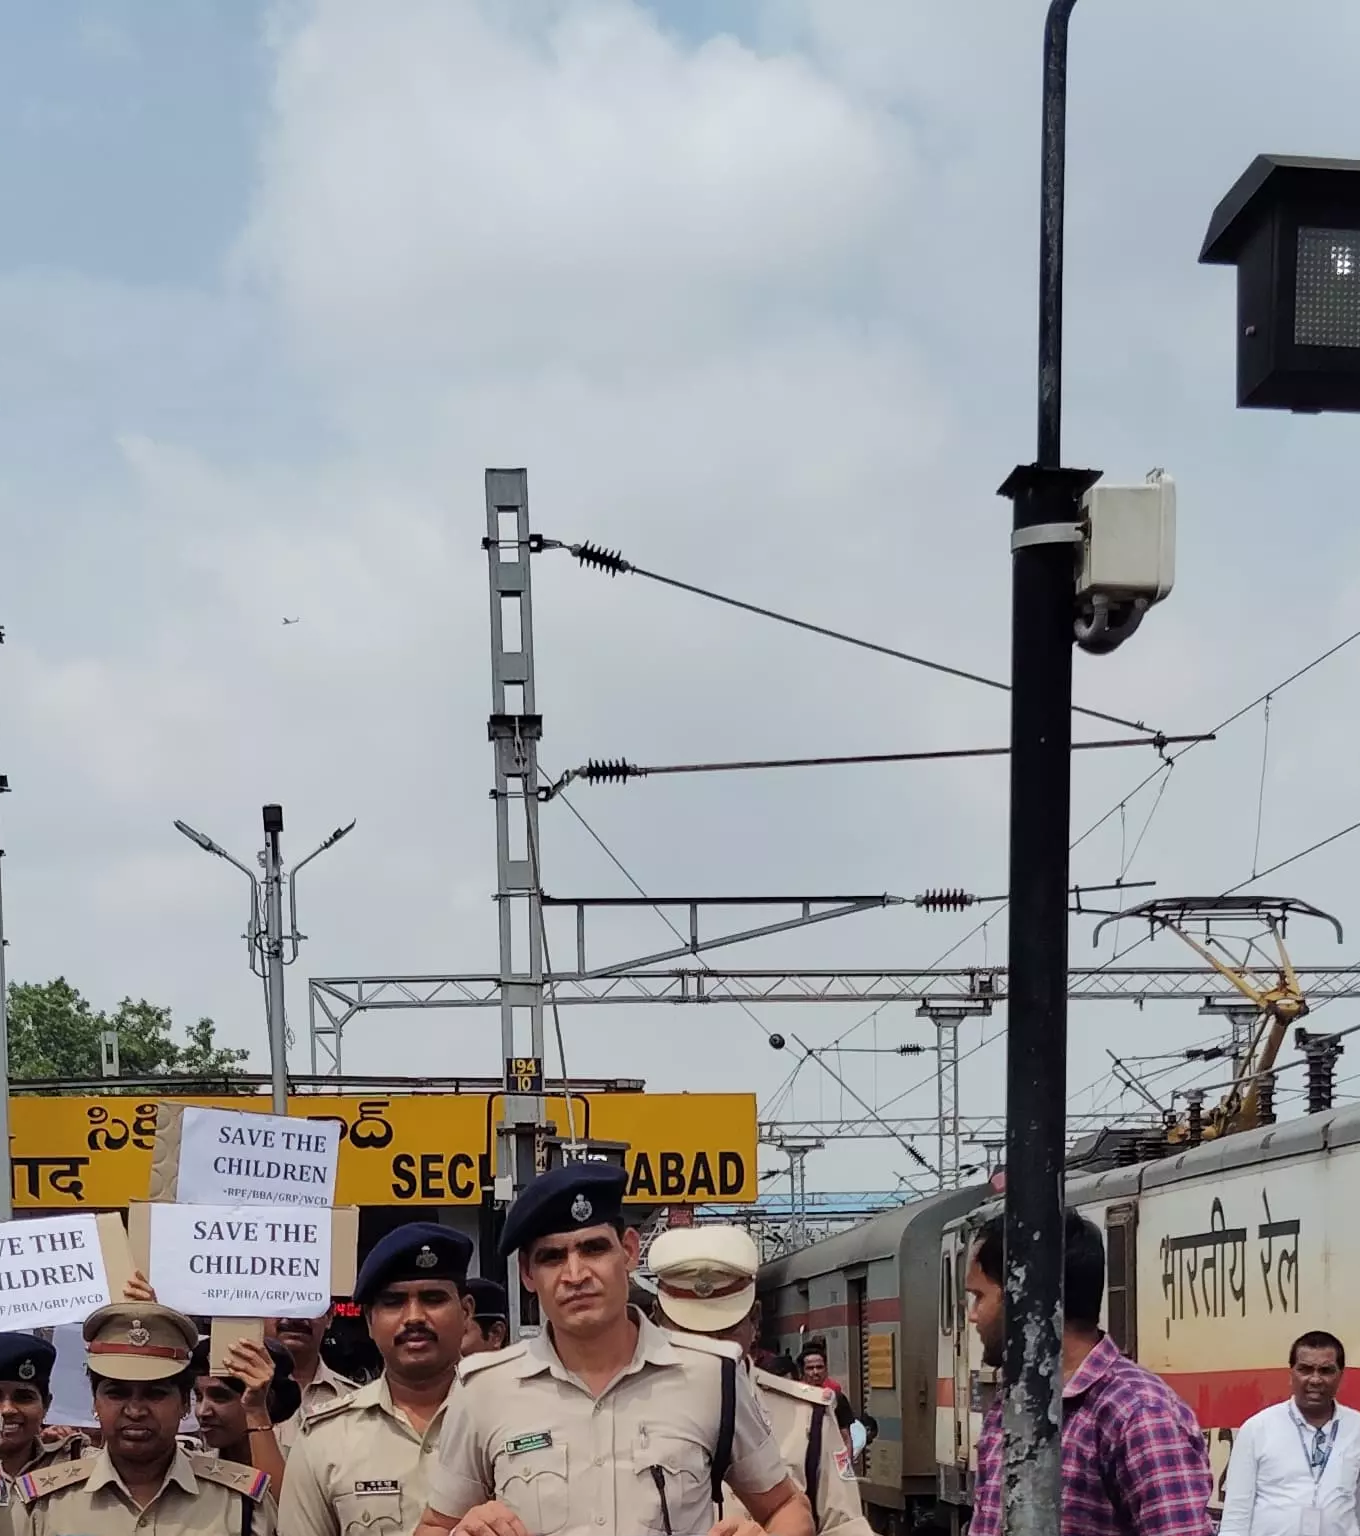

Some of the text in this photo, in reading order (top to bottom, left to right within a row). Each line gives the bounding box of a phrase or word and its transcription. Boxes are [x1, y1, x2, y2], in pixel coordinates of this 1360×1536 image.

[512, 1059, 537, 1075] 194
[517, 1077, 533, 1092] 10
[218, 1126, 328, 1154] SAVE THE
[213, 1156, 328, 1184] CHILDREN
[223, 1187, 328, 1206] -RPF/BBA/GRP/WCD
[29, 1230, 86, 1253] THE
[193, 1220, 318, 1244] SAVE THE
[189, 1254, 320, 1278] CHILDREN
[1159, 1187, 1301, 1341] भारतीय रेल
